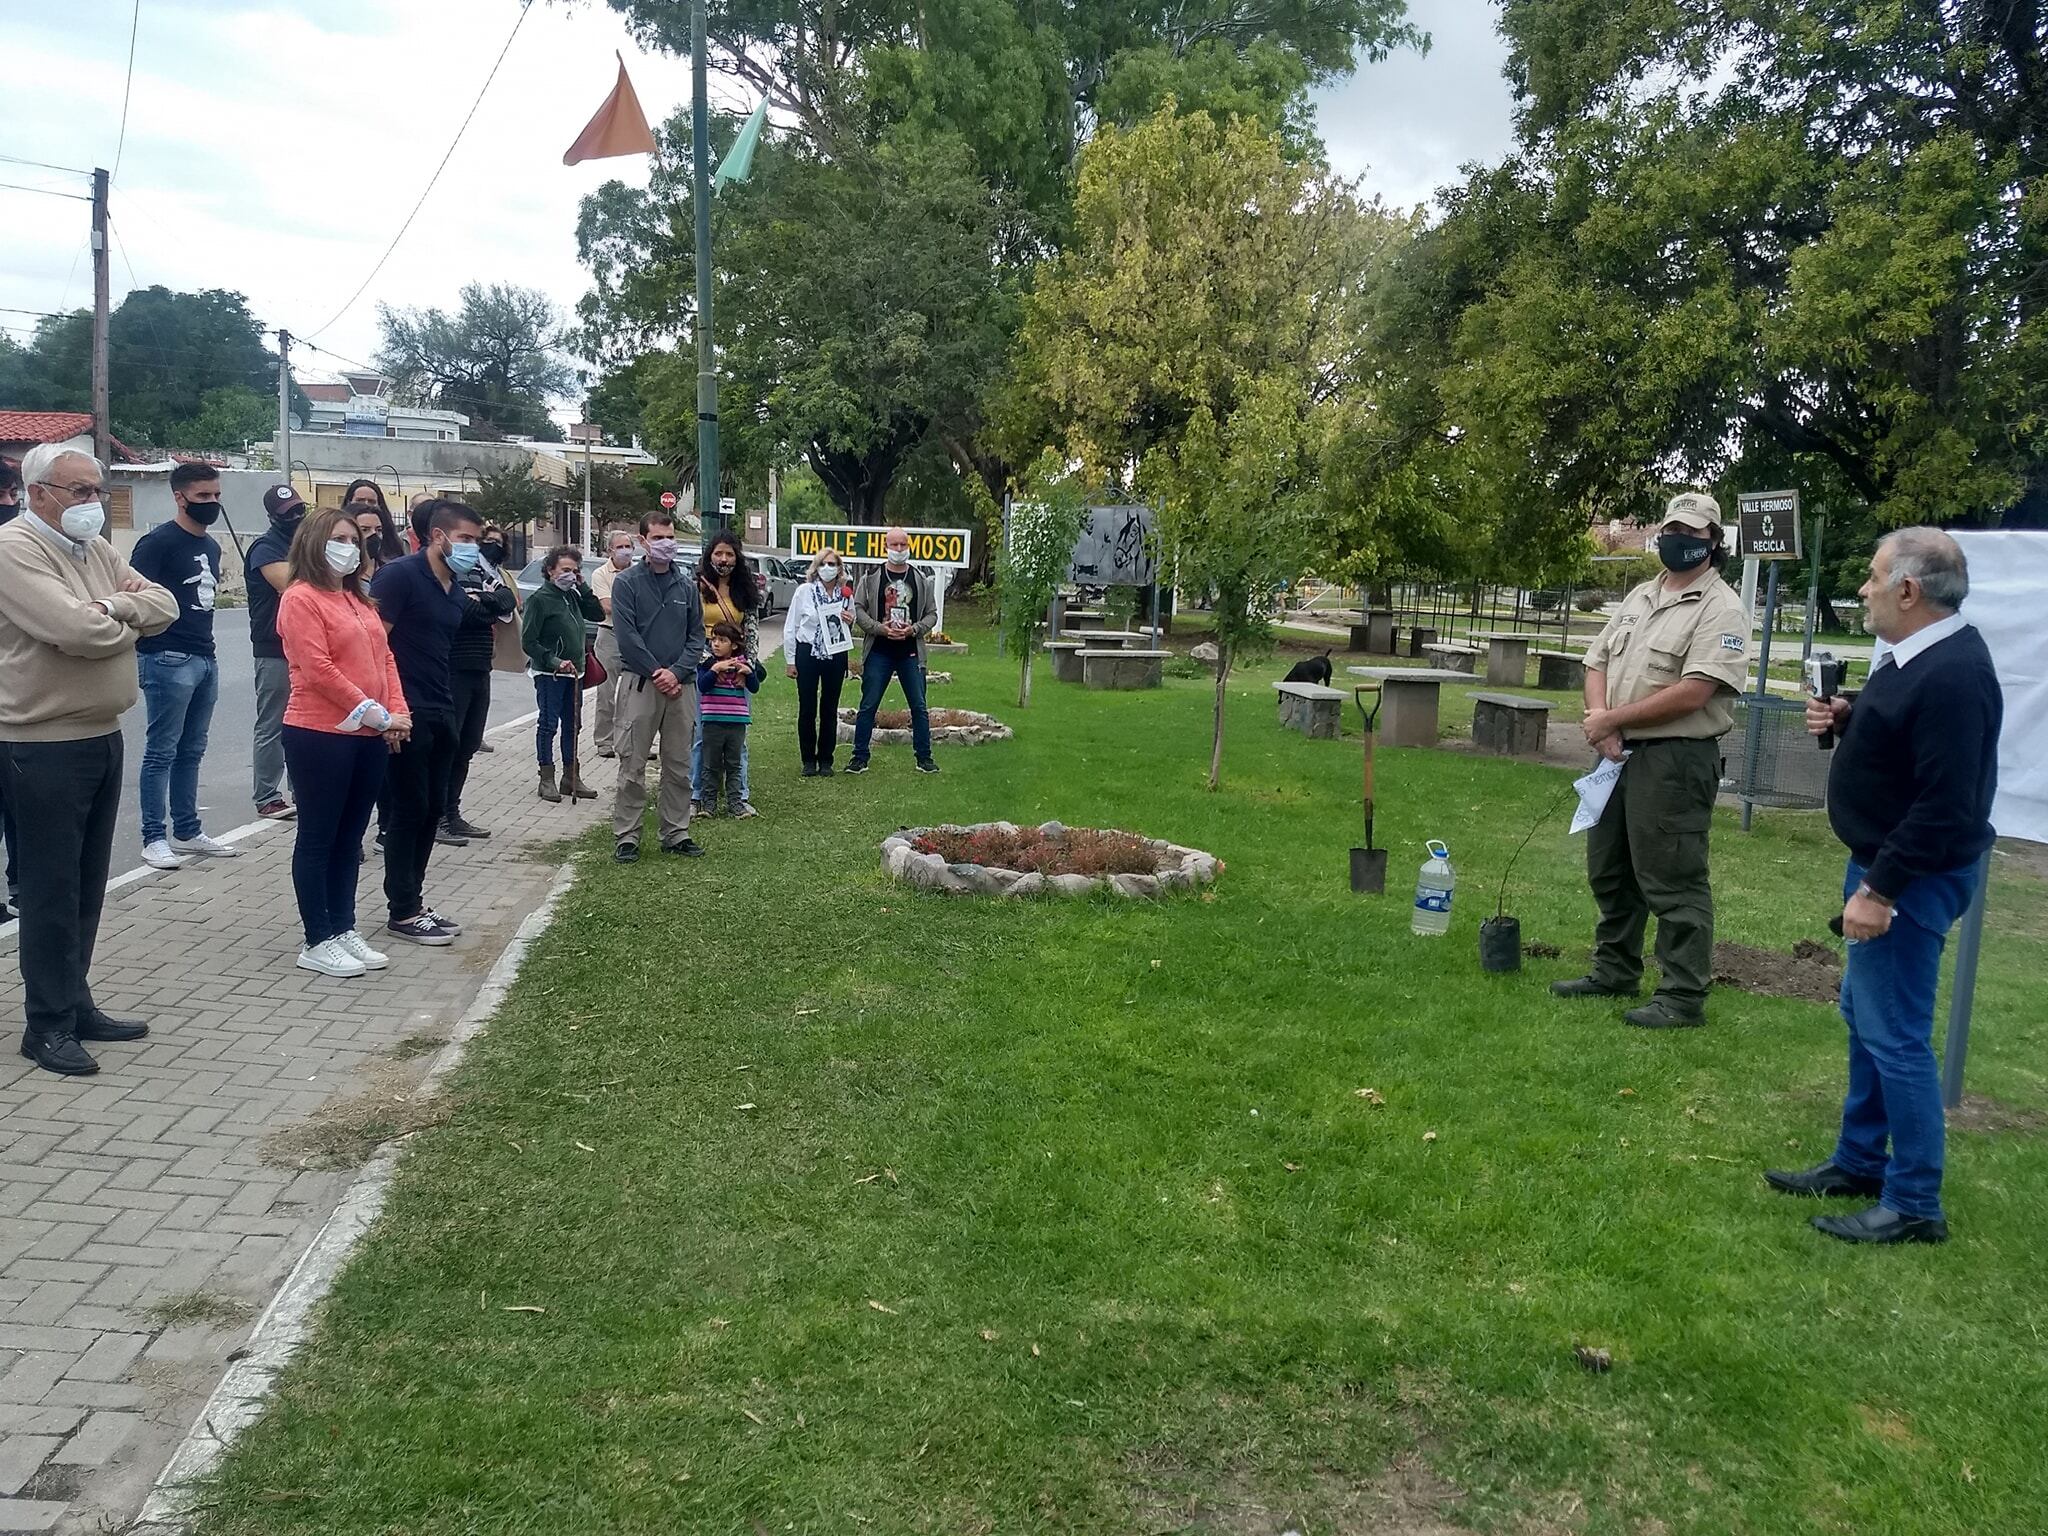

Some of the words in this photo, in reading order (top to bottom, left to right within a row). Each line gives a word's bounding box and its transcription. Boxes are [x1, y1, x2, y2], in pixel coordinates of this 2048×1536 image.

[1742, 500, 1760, 513] VALLE
[1760, 499, 1793, 512] HERMOSO
[800, 530, 858, 556] VALLE
[867, 532, 961, 561] HEMOSO
[1753, 540, 1786, 552] RECICLA
